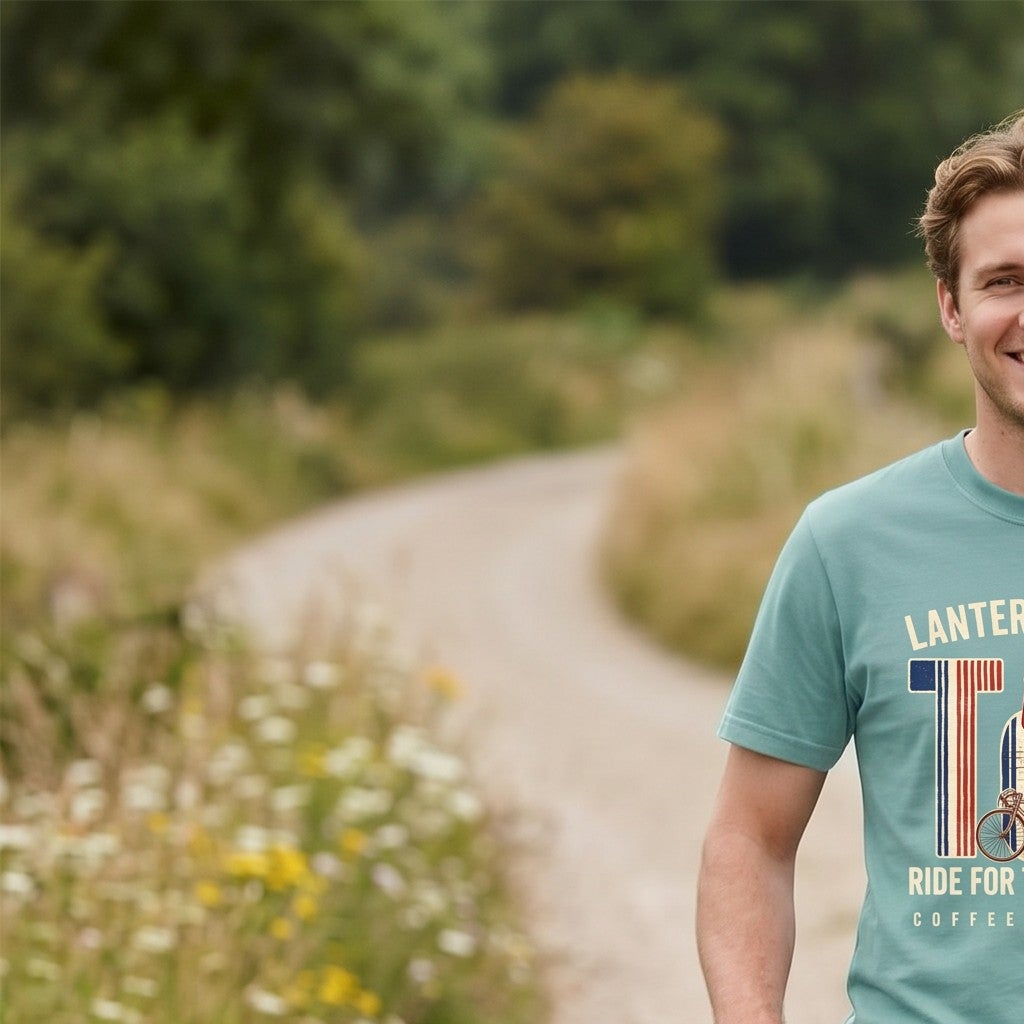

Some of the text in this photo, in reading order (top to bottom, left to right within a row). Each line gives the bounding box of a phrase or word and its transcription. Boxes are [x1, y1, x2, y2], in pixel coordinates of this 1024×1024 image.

[909, 867, 962, 895] RIDE
[971, 867, 1015, 895] FOR
[914, 912, 1014, 926] COFFEE
